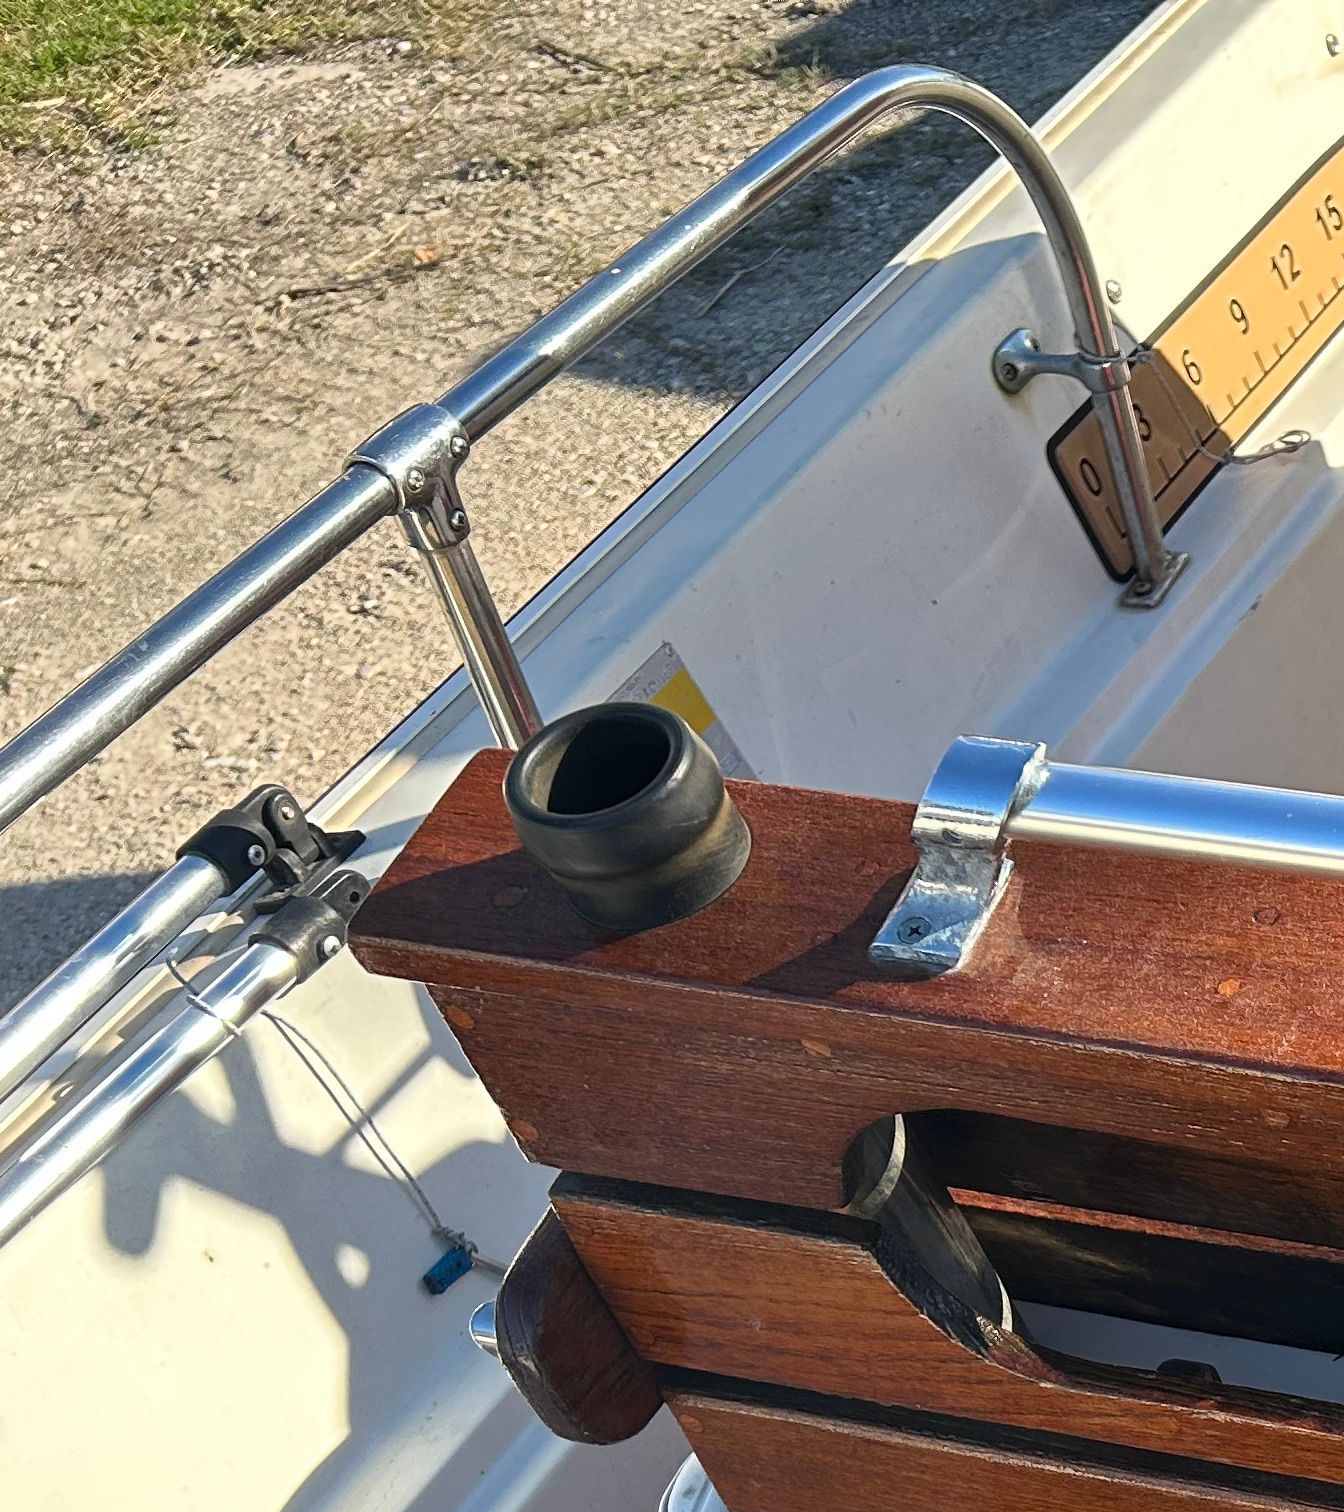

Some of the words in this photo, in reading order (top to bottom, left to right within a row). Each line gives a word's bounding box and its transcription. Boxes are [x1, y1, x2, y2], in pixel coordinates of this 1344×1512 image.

[1080, 457, 1102, 497] 0
[1132, 403, 1151, 441] 3
[1182, 349, 1202, 385] 6
[1230, 299, 1250, 335] 9
[1271, 243, 1301, 290] 12
[1315, 194, 1344, 241] 15
